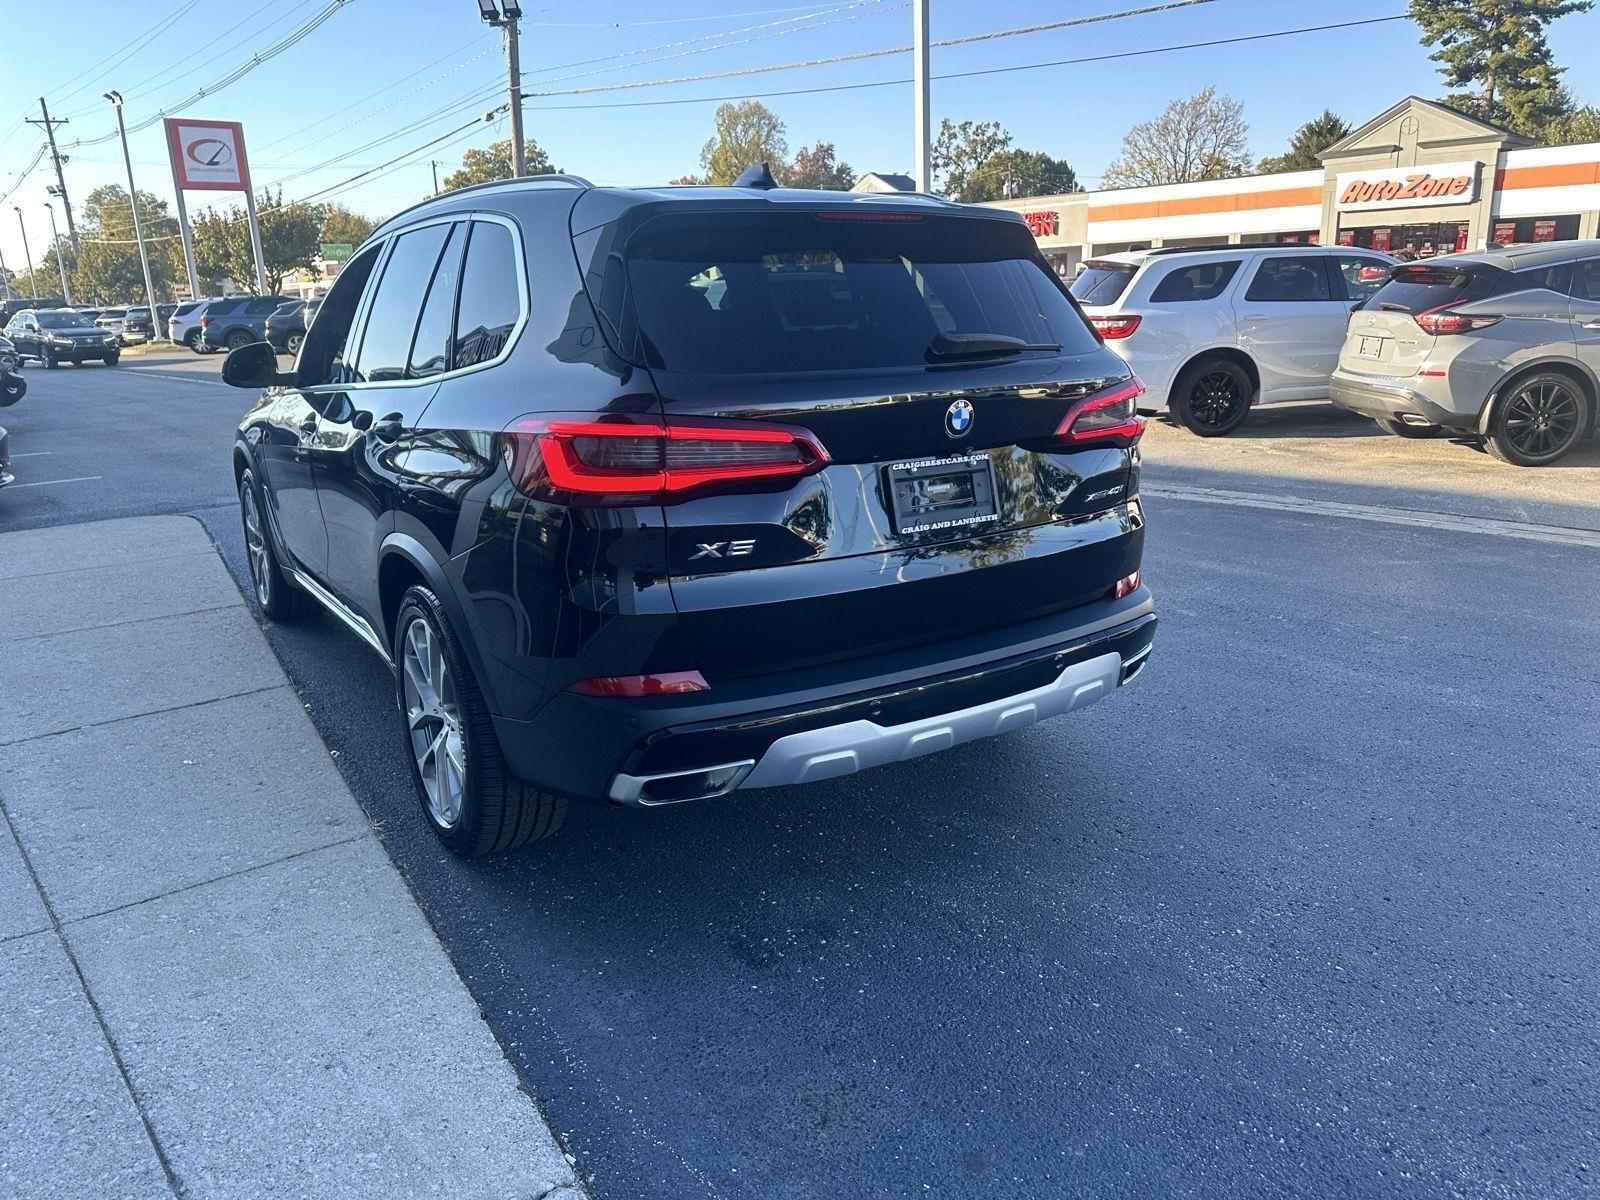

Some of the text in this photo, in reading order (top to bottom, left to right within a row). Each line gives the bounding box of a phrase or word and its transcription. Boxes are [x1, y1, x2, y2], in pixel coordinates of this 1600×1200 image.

[1340, 174, 1469, 203] AutoZone
[893, 454, 989, 471] CRAIGSBESTCARS.COM
[901, 514, 998, 535] CRAIG AND LANDRETH
[688, 539, 756, 560] X5
